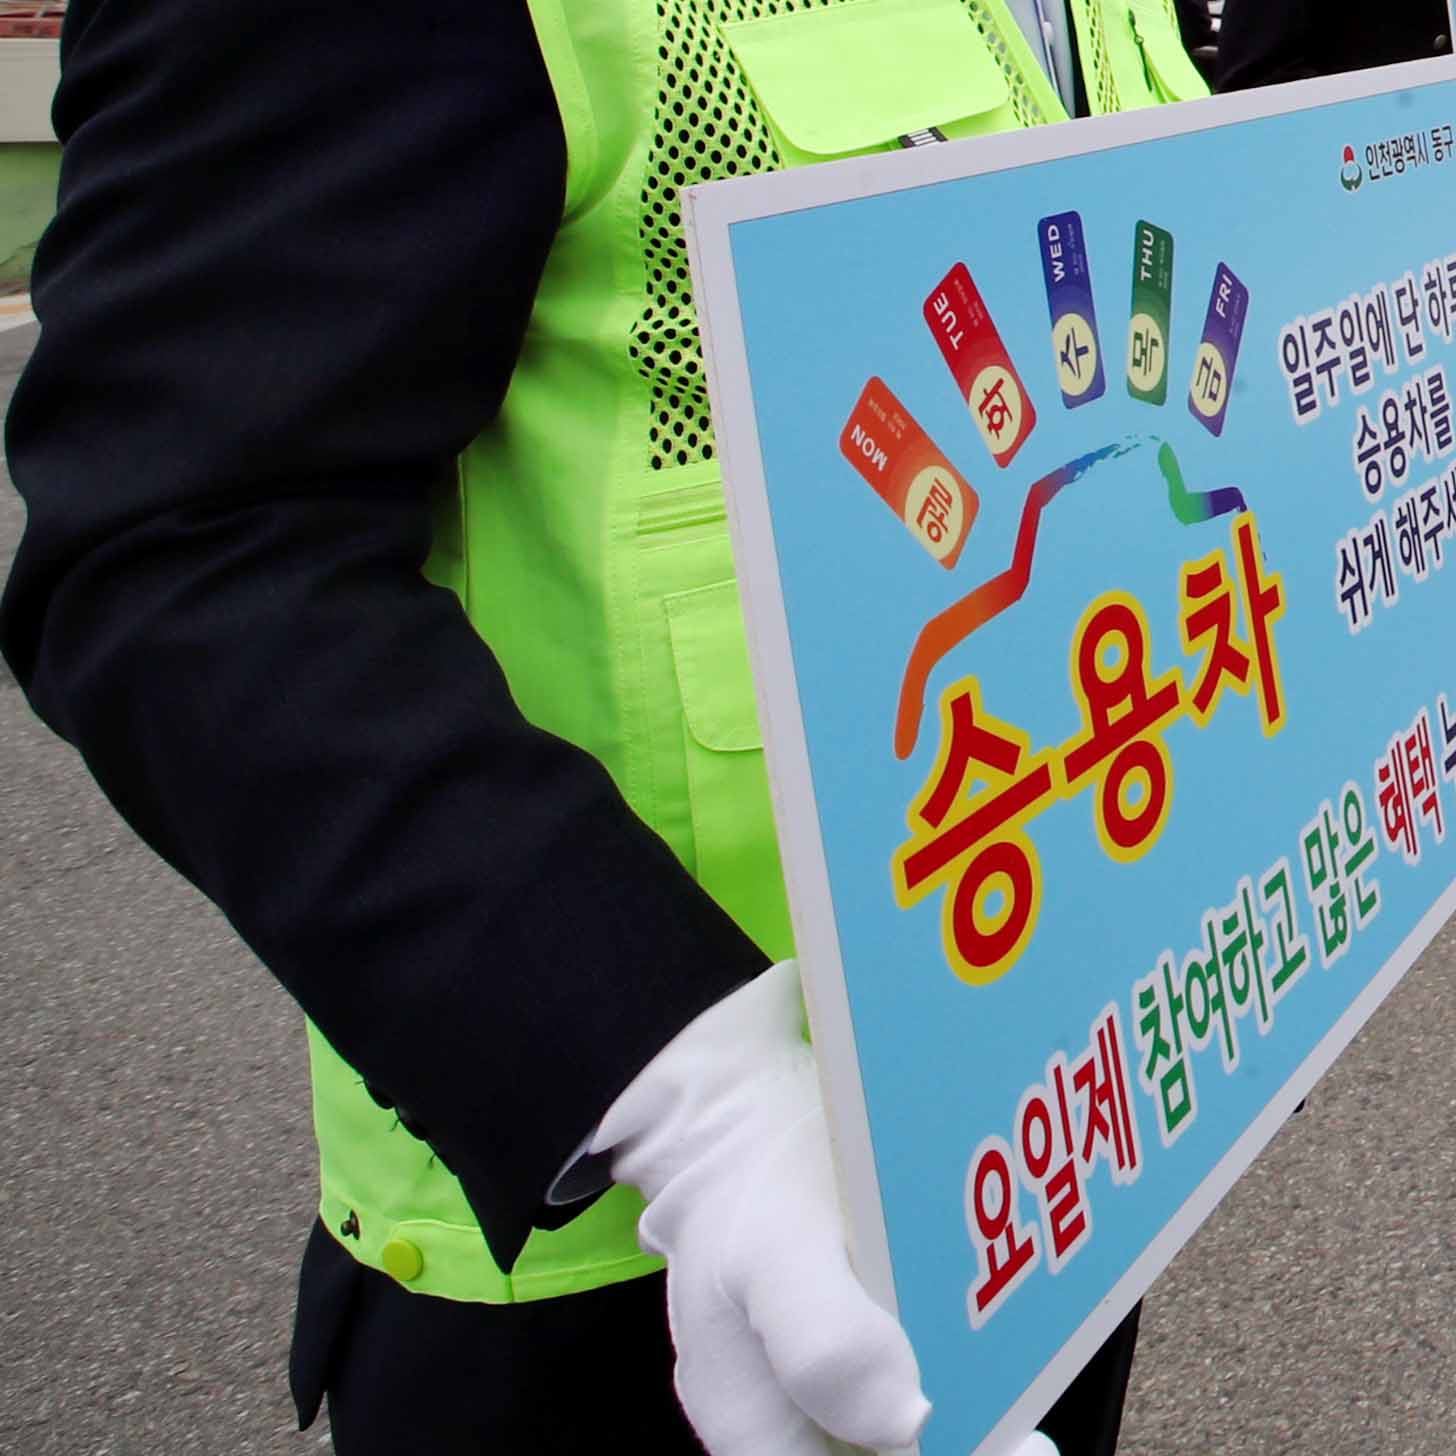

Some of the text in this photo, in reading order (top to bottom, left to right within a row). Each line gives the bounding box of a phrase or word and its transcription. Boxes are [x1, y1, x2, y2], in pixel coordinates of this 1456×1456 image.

[1364, 125, 1454, 181] 인천광역시 동구
[1047, 224, 1066, 283] WED
[1140, 229, 1155, 281] THU
[932, 291, 966, 351] TUE
[1214, 273, 1233, 319] FRI
[1060, 327, 1090, 380] 수
[1132, 327, 1160, 377] 목
[1281, 290, 1396, 417] 일주일에
[1394, 278, 1424, 357] 단
[977, 377, 1014, 440] 화
[1195, 356, 1222, 404] 금
[850, 424, 888, 472] MON
[1356, 371, 1453, 495] 승용차를
[916, 477, 953, 544] 월
[1339, 518, 1395, 625] 쉬게
[903, 524, 1281, 968] 승용차
[972, 1013, 1137, 1314] 요일제
[1138, 868, 1307, 1134] 참여하고
[1305, 787, 1379, 958] 많은
[1377, 716, 1443, 856] 혜택
